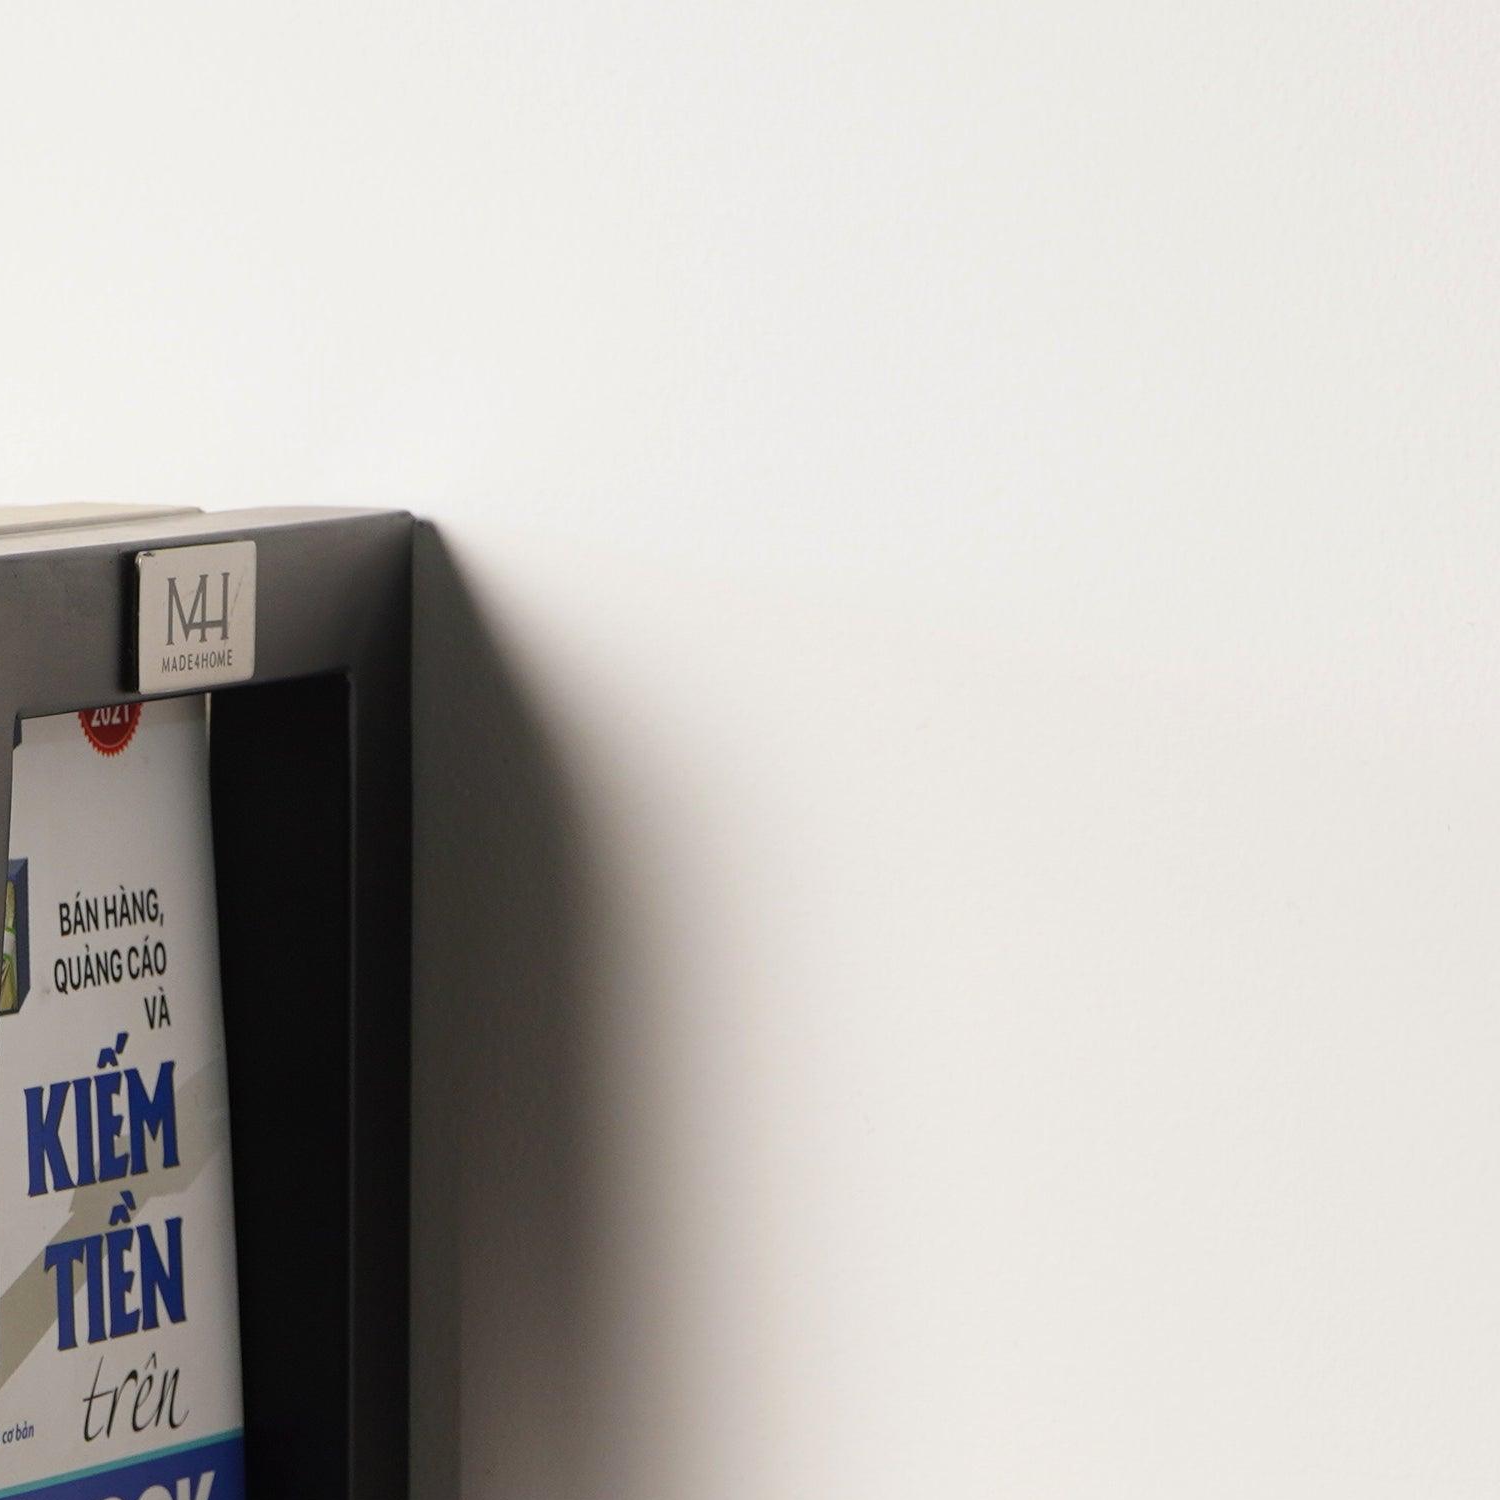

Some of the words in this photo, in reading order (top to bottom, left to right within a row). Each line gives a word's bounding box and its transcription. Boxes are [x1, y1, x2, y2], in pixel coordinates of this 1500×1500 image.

[161, 649, 233, 673] MADE4HOME
[59, 892, 99, 937] BÁN
[104, 884, 164, 929] HÀNG,
[54, 944, 123, 994] QUẢNG
[128, 936, 167, 980] CÁO
[143, 987, 171, 1029] VÀ
[24, 1031, 180, 1197] KIẾM
[43, 1190, 187, 1351] TIỀN
[82, 1352, 189, 1442] trên
